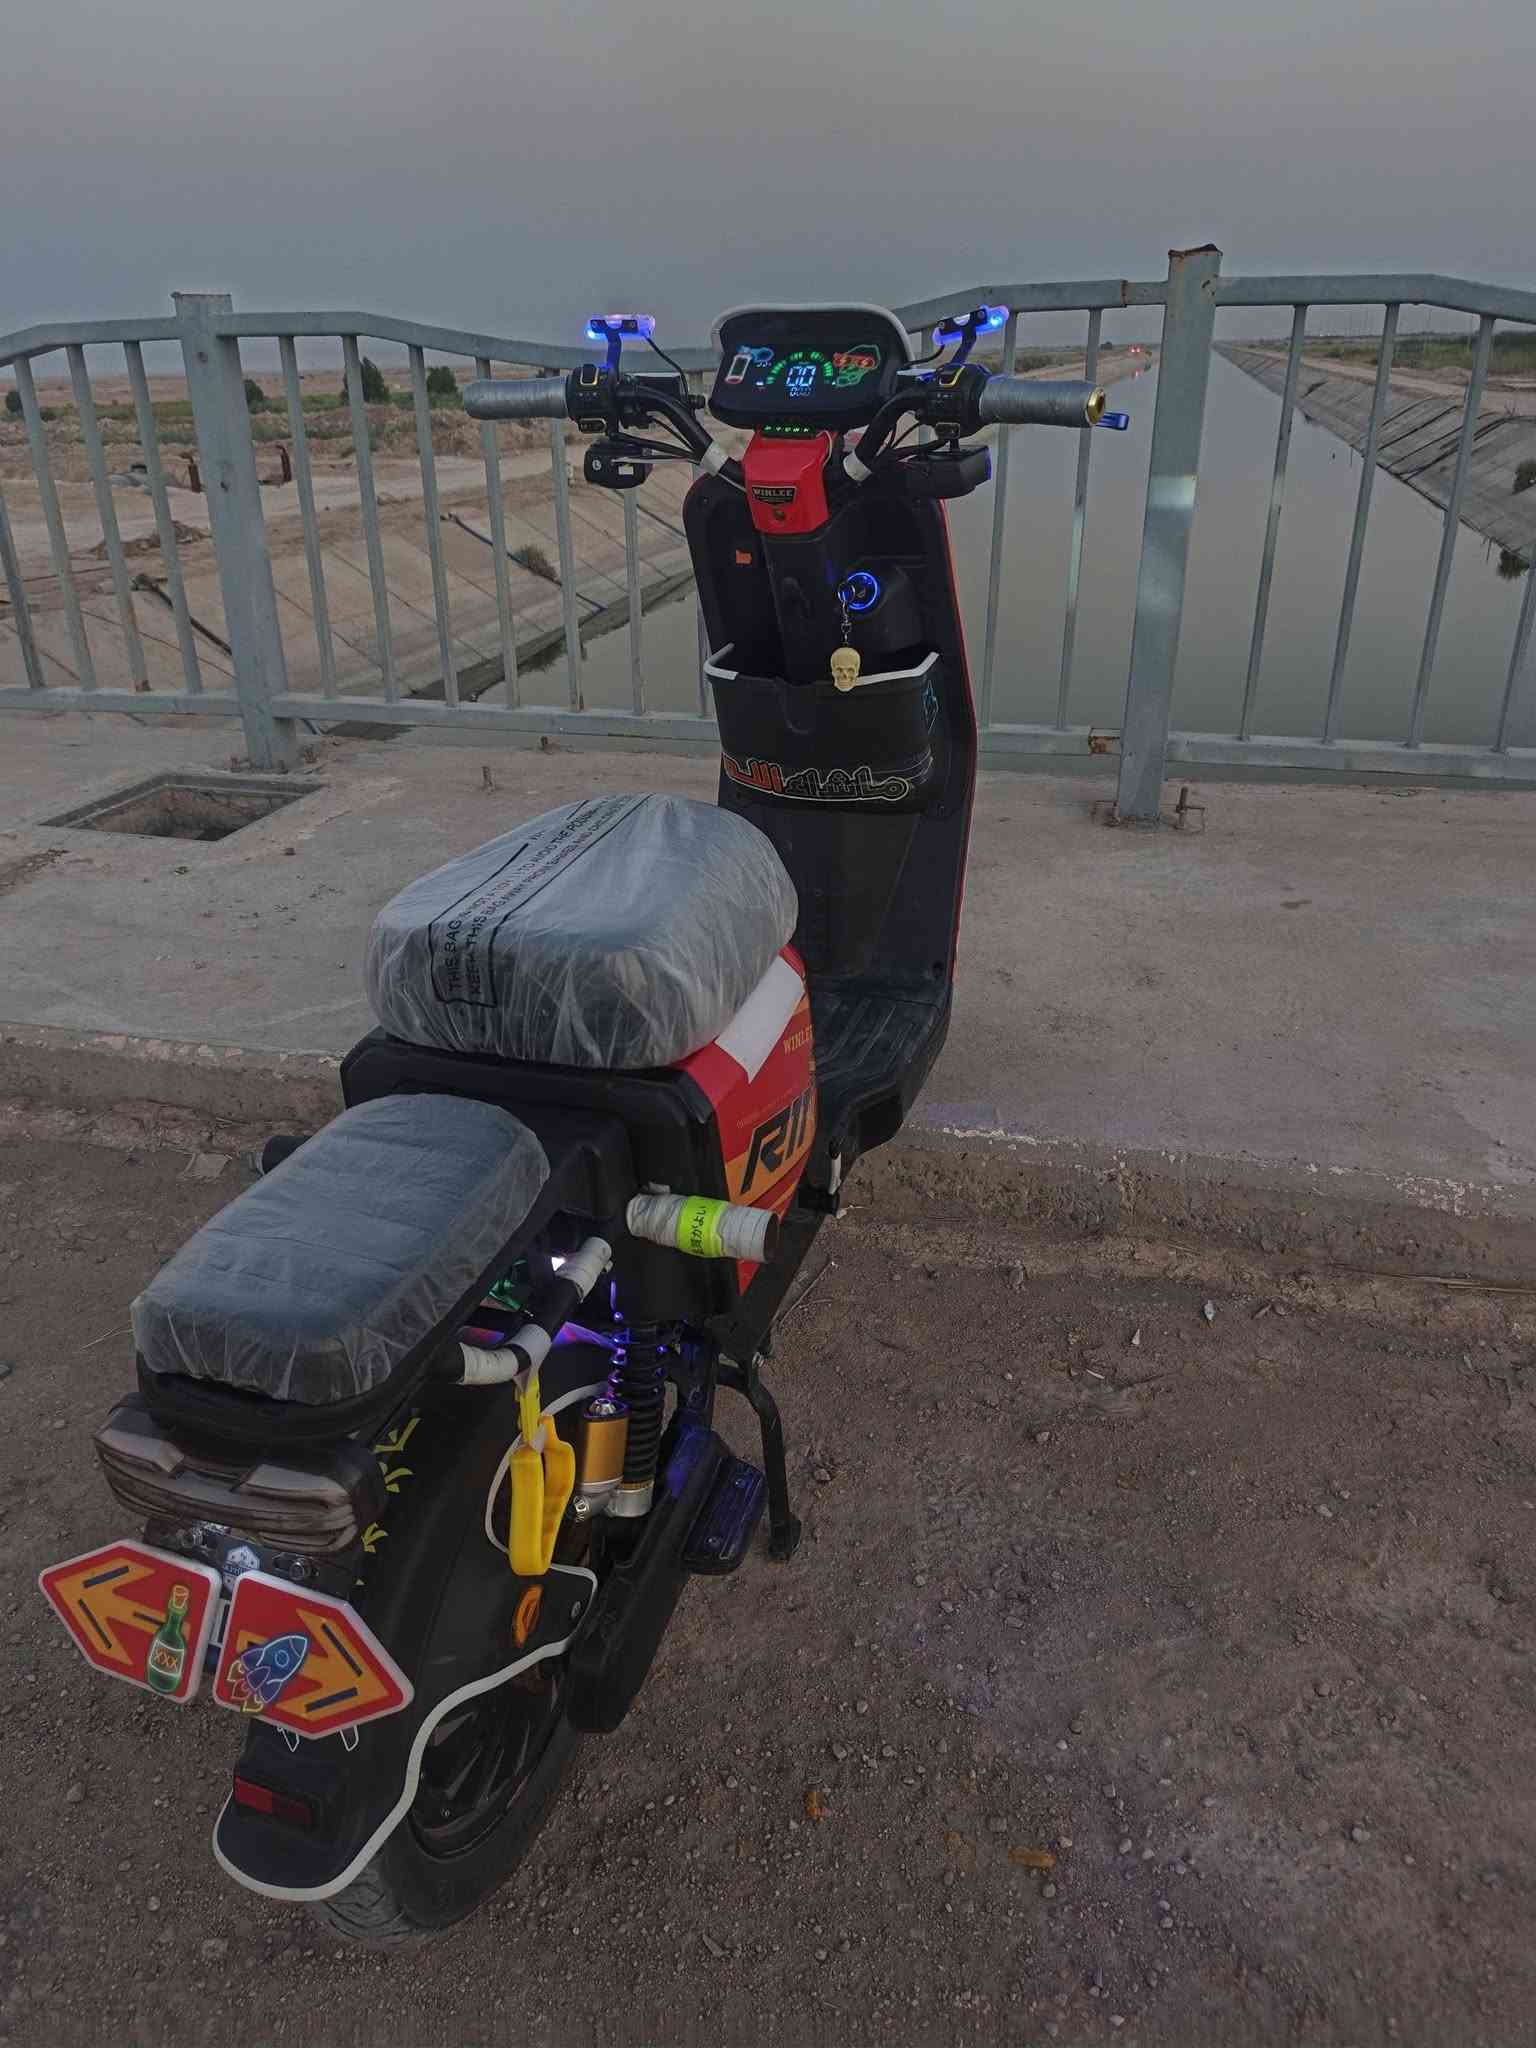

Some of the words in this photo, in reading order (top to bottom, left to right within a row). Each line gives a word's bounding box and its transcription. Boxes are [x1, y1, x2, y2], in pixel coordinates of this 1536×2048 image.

[444, 919, 462, 953] BAG
[465, 915, 487, 946] THIS
[155, 1648, 177, 1669] XXX
